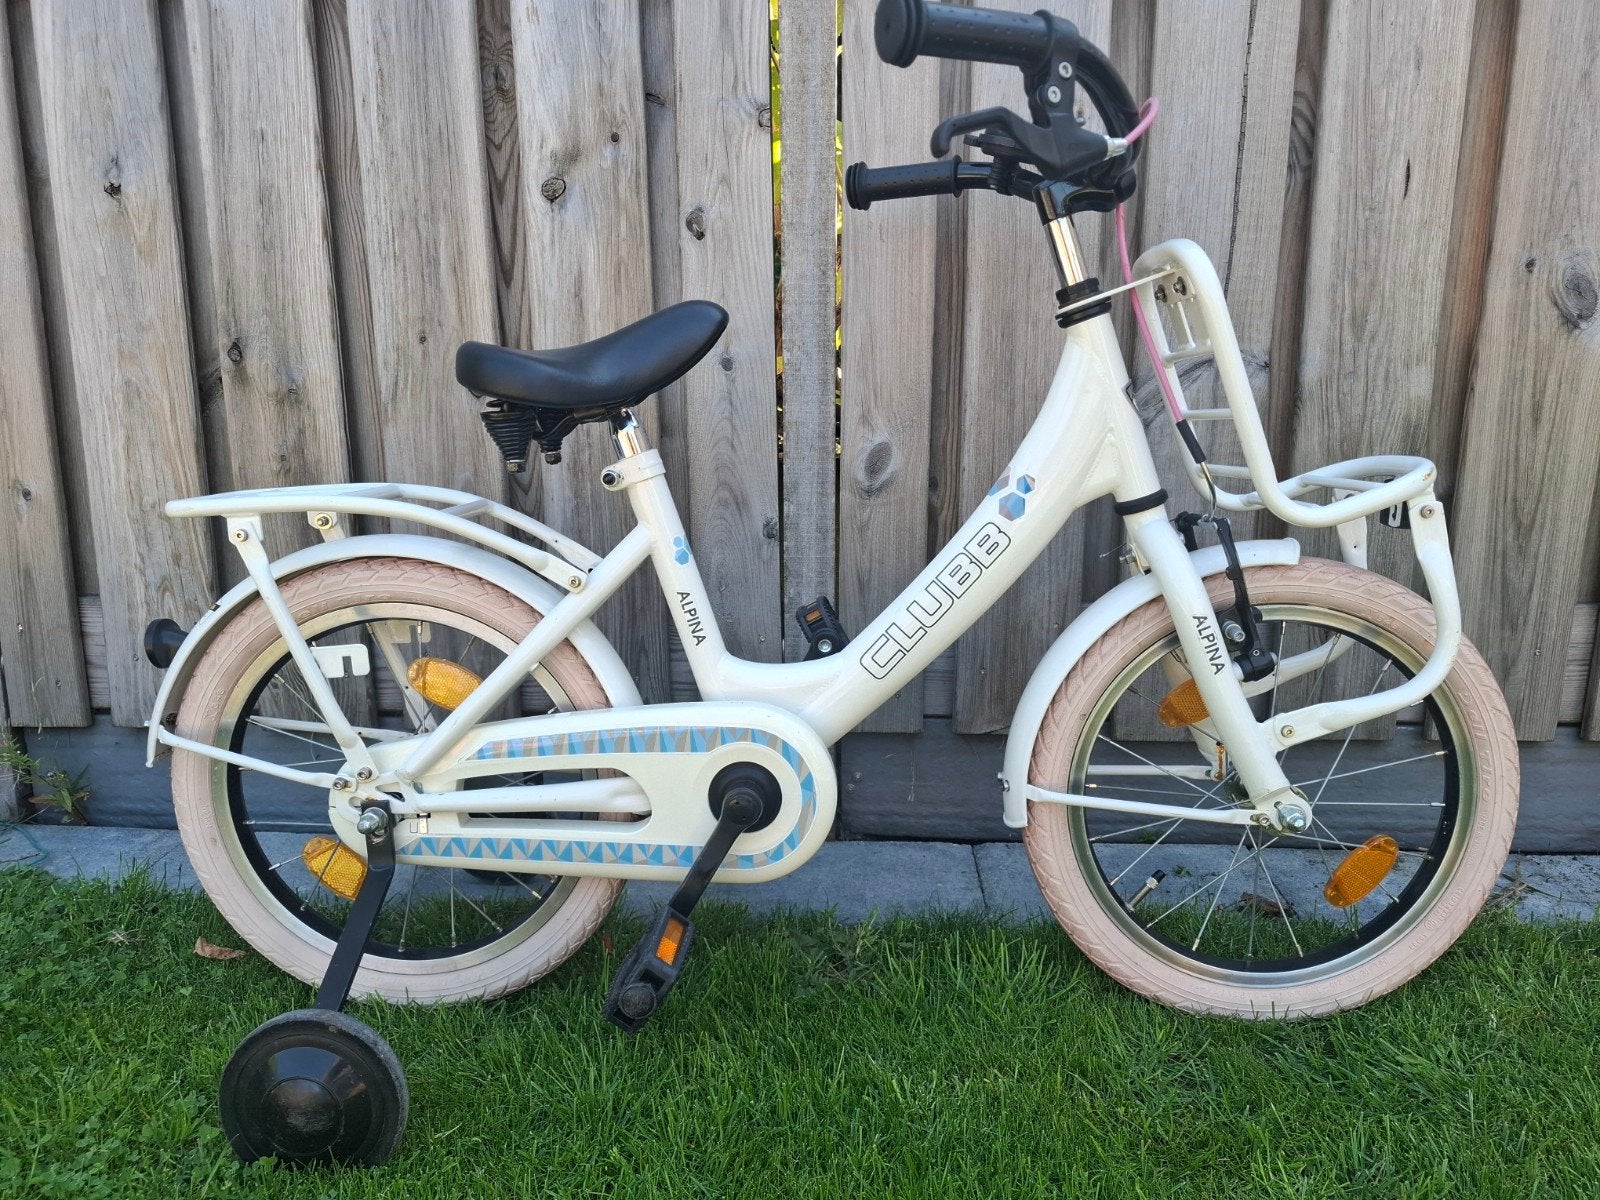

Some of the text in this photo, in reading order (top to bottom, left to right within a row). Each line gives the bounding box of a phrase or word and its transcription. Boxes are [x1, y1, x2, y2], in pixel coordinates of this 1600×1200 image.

[677, 591, 707, 646] ALPINA
[860, 522, 1011, 679] CLUBB
[1192, 615, 1226, 675] ALPINA
